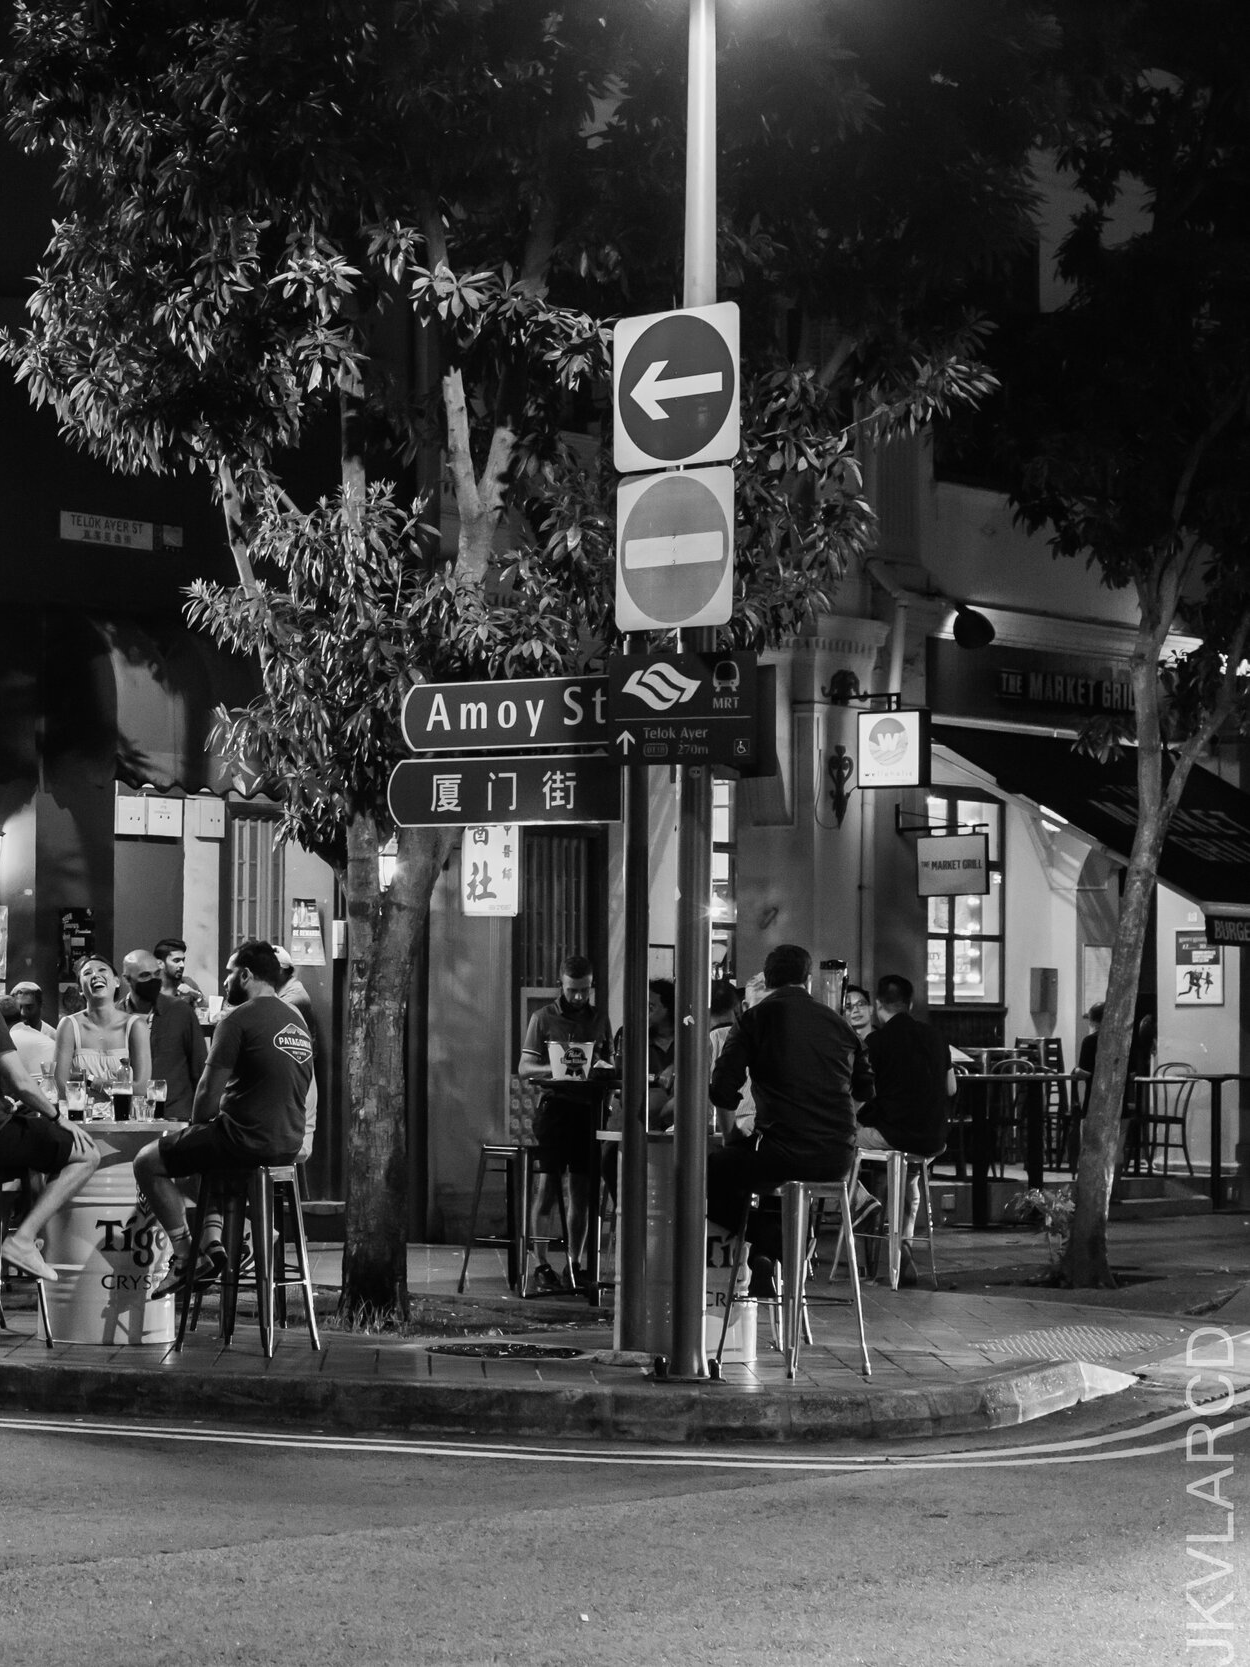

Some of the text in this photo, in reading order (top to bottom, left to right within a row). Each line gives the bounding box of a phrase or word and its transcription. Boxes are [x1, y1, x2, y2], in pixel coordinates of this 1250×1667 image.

[71, 514, 143, 534] TELOK AYER ST
[1001, 672, 1136, 711] THE MARKET GRIL
[712, 696, 740, 709] MRT
[425, 686, 607, 737] Amoy St
[642, 727, 708, 742] Telok Ayer
[677, 744, 709, 755] 270m
[430, 770, 577, 812] 厦门街
[931, 860, 961, 871] MARKET
[963, 859, 983, 869] GRILL
[101, 1274, 152, 1290] CRYS
